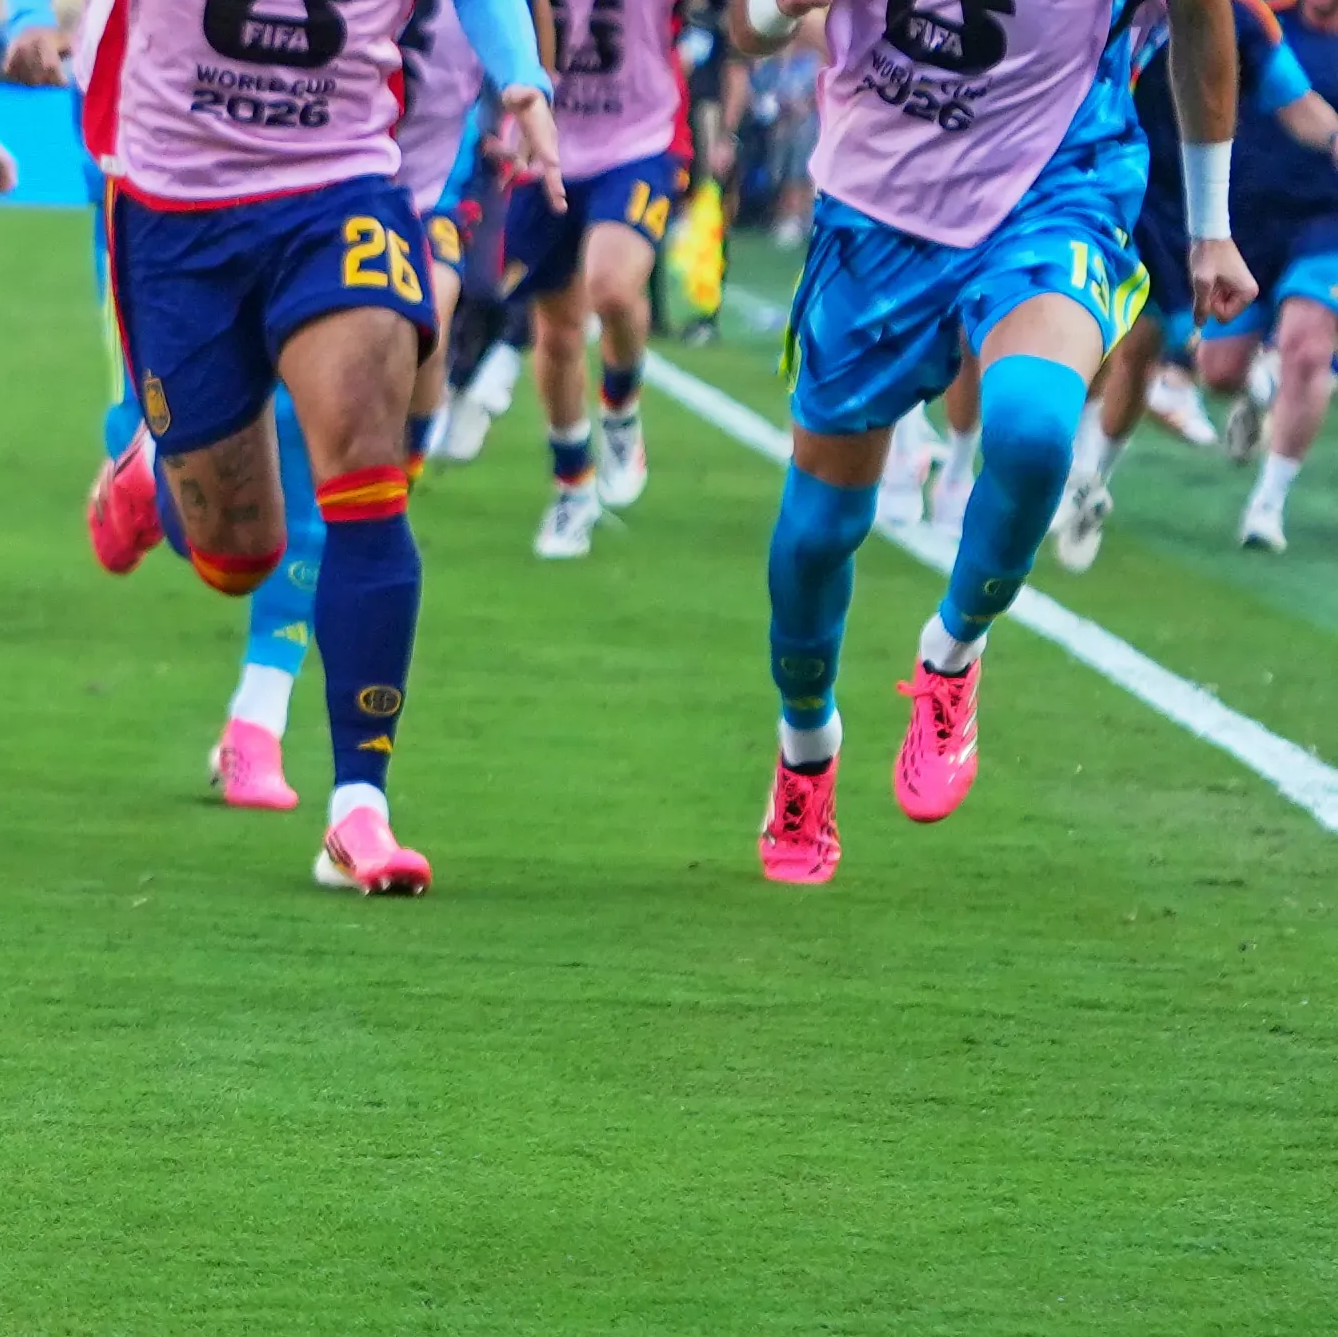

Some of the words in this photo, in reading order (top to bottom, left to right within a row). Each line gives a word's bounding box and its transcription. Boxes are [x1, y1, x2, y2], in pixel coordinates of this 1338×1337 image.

[240, 20, 310, 53] FIFA
[907, 17, 965, 58] FIFA
[197, 63, 287, 92] WORLD
[290, 77, 337, 97] CUP
[189, 89, 331, 128] 2026
[854, 74, 975, 131] 2026
[627, 179, 671, 240] 14
[342, 216, 423, 303] 26
